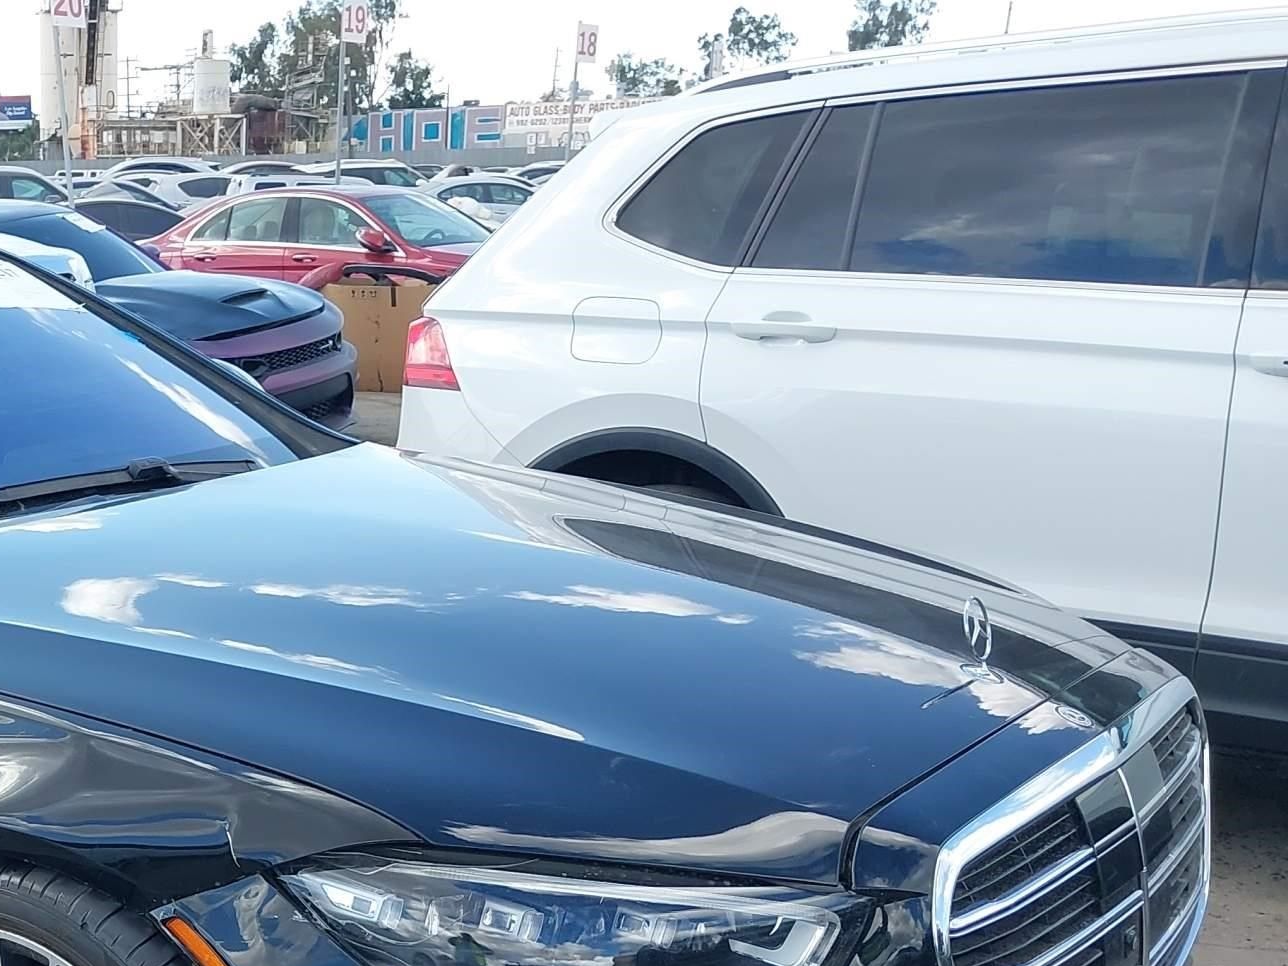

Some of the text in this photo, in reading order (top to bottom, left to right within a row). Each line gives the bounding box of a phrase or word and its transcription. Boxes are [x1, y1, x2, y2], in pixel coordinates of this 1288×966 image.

[54, 0, 82, 17] 20
[344, 5, 365, 34] 19
[577, 31, 597, 57] 18
[508, 105, 530, 117] AUTO
